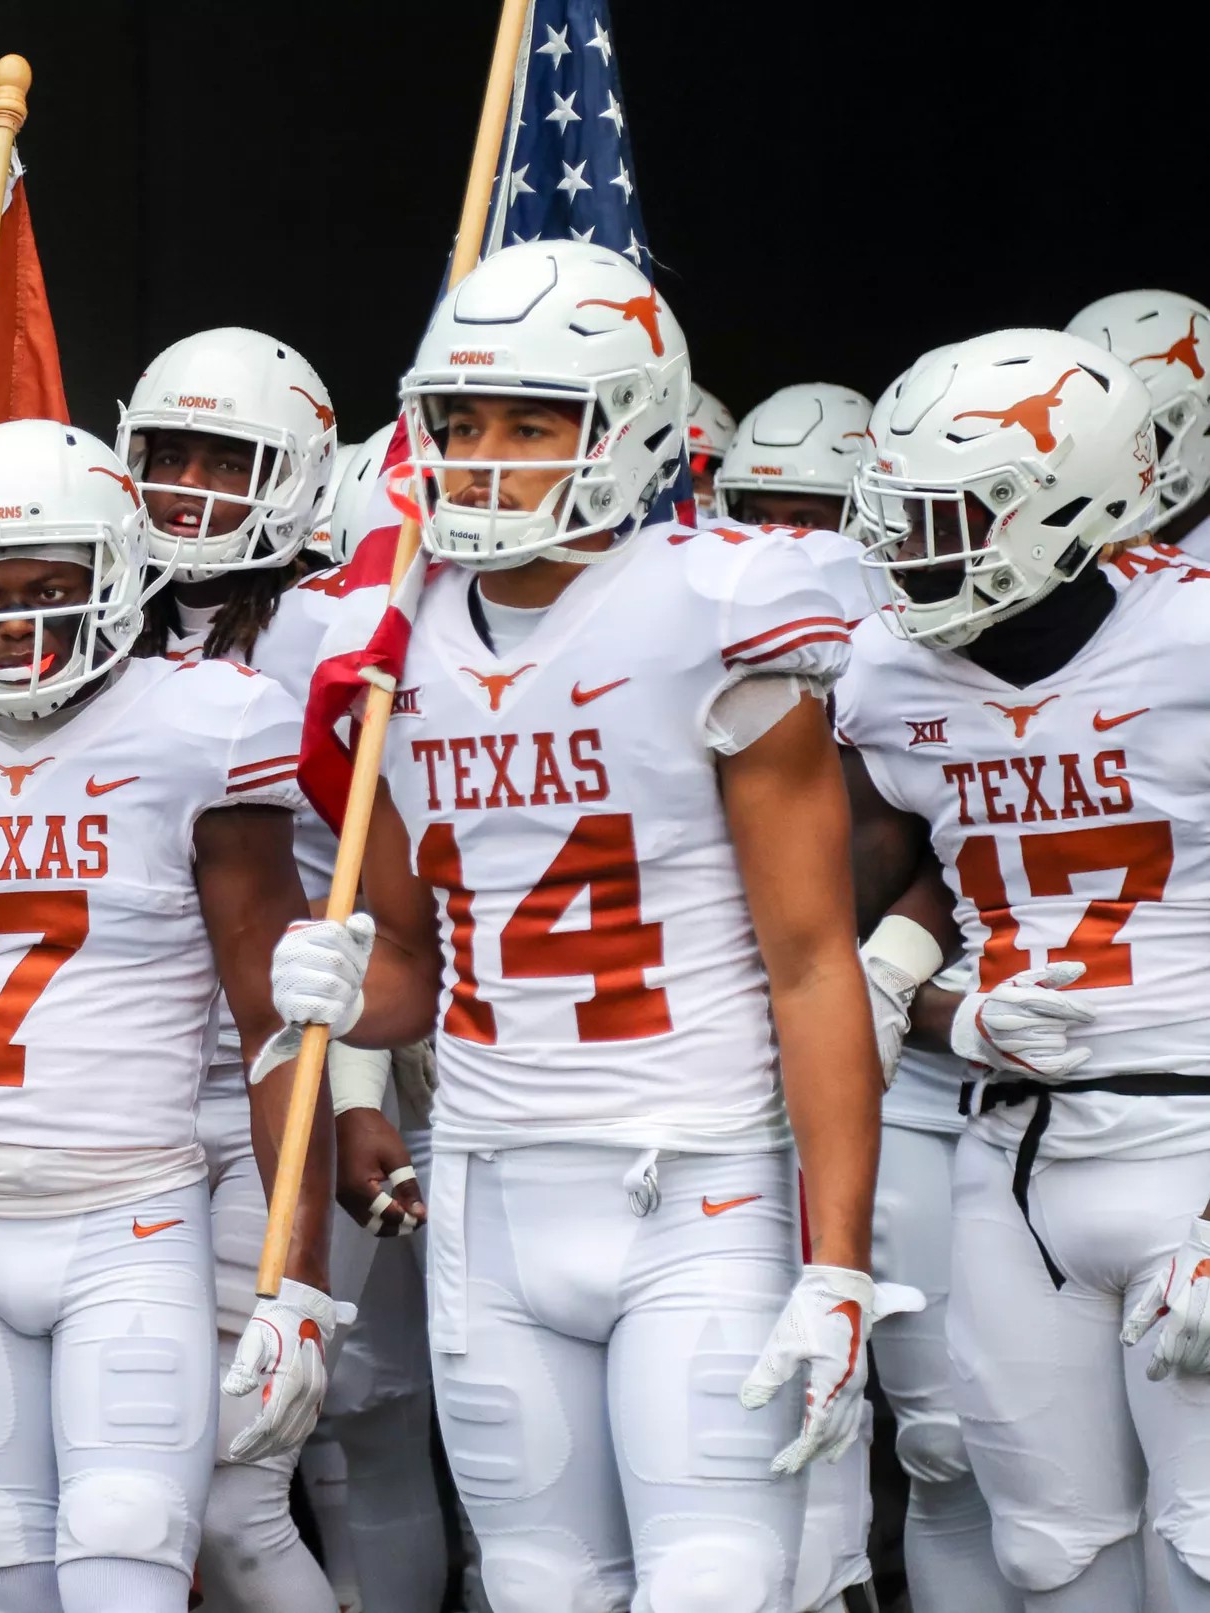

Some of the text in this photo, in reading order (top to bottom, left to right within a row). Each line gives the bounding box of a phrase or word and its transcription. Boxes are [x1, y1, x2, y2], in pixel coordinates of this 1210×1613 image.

[450, 351, 495, 366] HORNS
[178, 395, 218, 410] HORNS
[450, 529, 481, 541] Riddell
[905, 716, 948, 746] XII
[412, 728, 611, 810] TEXAS
[943, 749, 1135, 826] TEXAS
[416, 812, 675, 1046] 14
[954, 819, 1176, 994] 17
